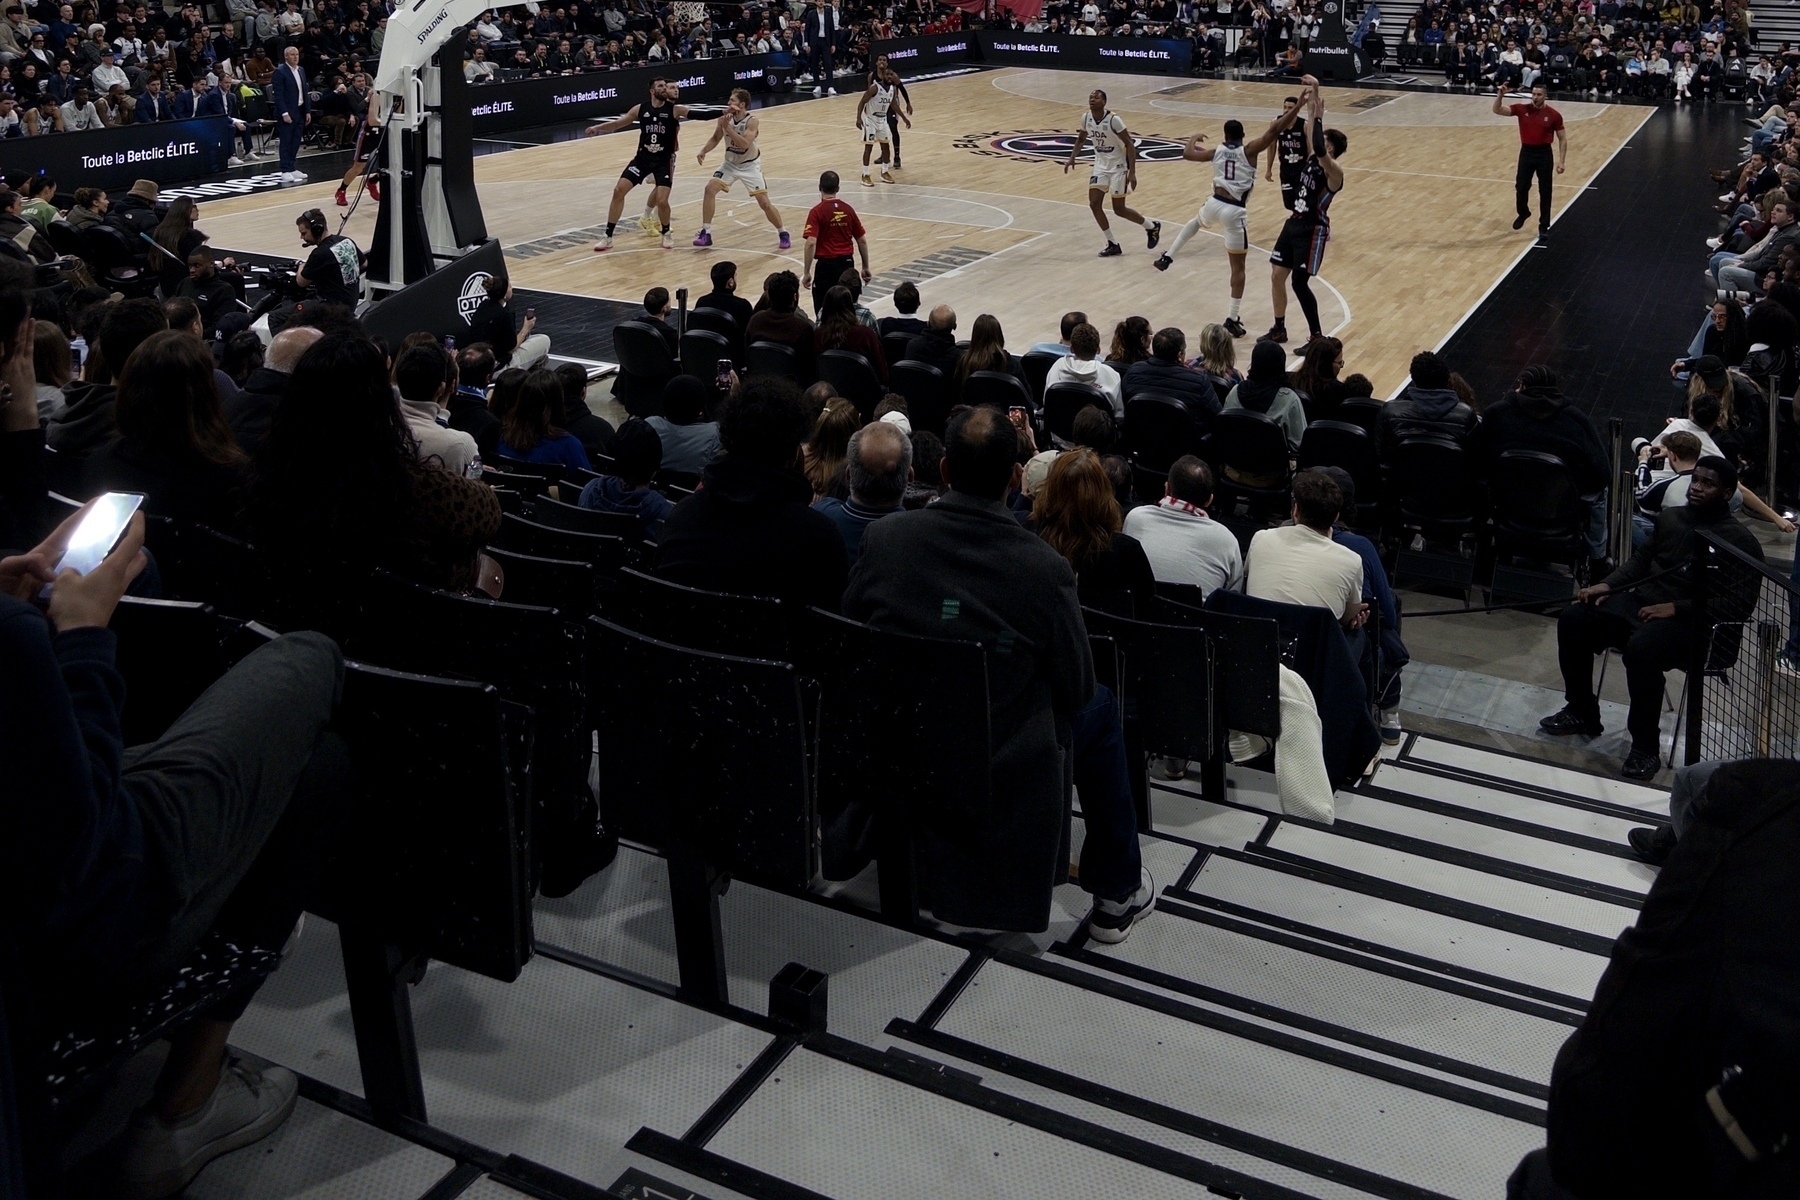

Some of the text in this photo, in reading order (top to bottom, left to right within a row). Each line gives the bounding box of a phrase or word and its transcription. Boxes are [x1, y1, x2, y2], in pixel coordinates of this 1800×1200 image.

[417, 8, 448, 45] SPALDING
[993, 42, 1060, 53] Toute la Betclic ÉLITE.
[1098, 48, 1171, 60] Toute la Betclic ÉLITE.
[553, 87, 618, 106] Toute la Betclic ÉLITE.
[471, 100, 515, 117] etclic ÉLITE.
[645, 123, 666, 135] PARIS
[650, 133, 658, 144] 8
[81, 140, 199, 169] Toute la Betclic ÉLITE.
